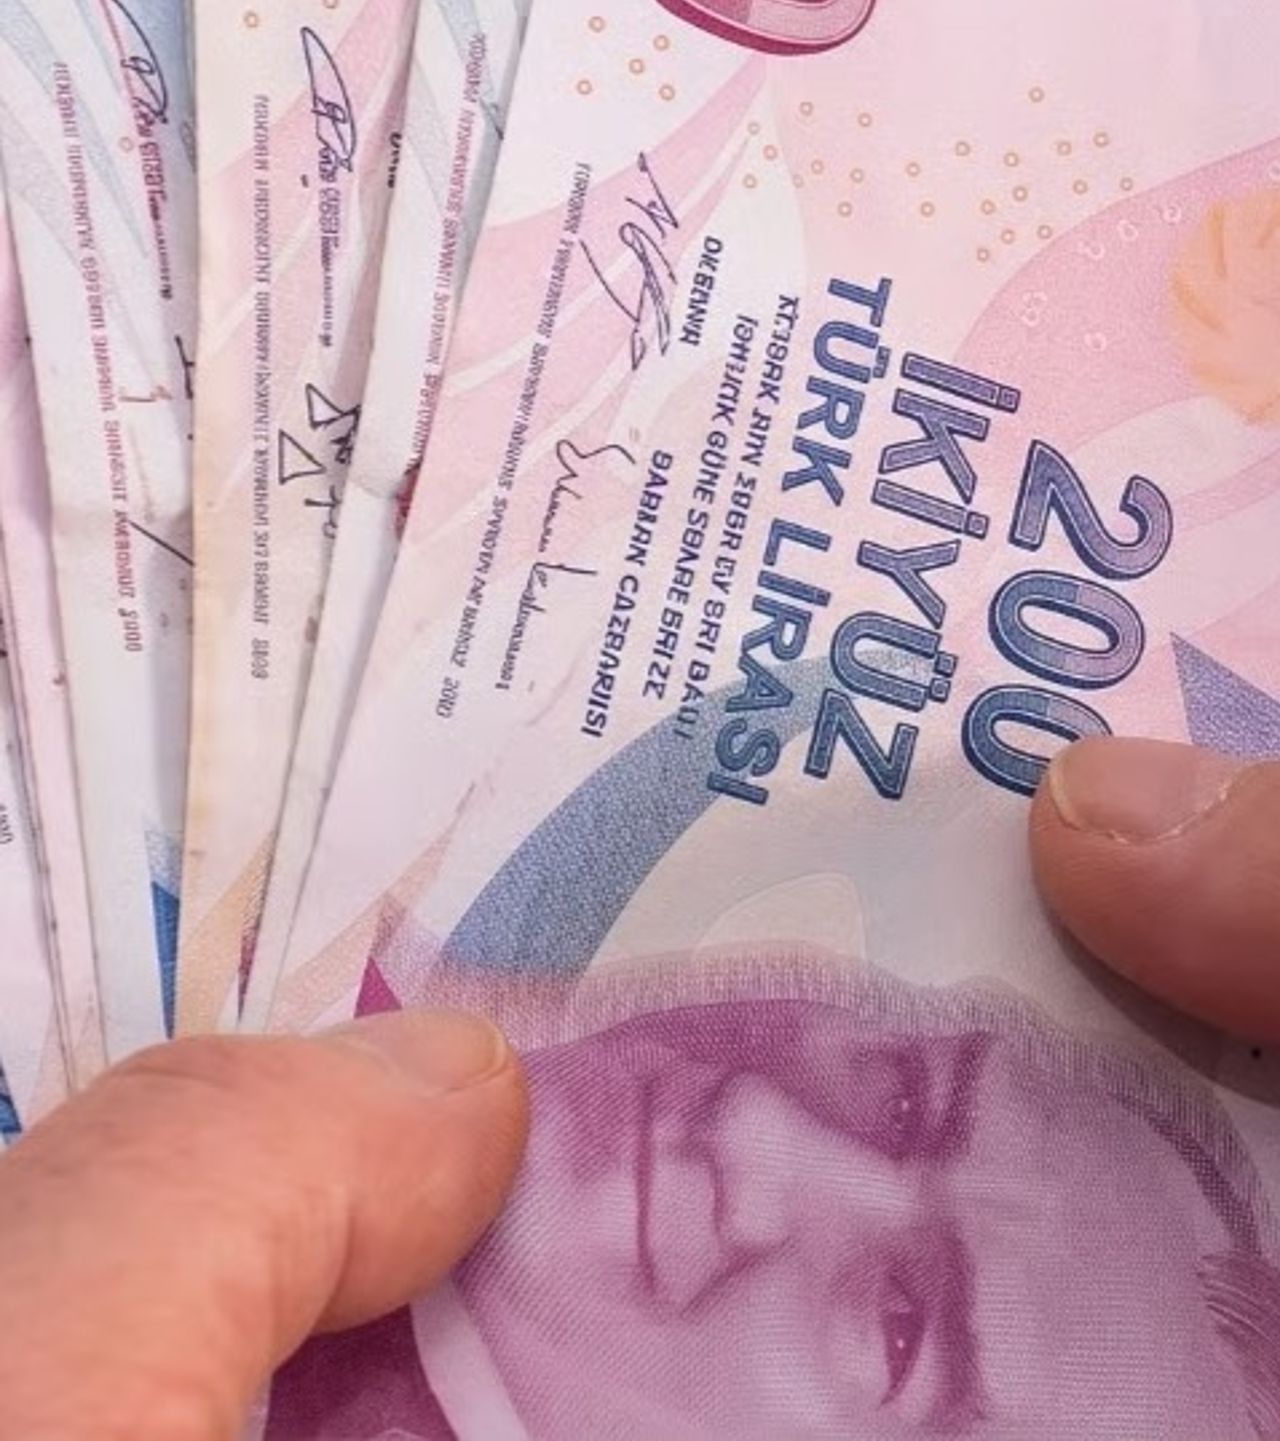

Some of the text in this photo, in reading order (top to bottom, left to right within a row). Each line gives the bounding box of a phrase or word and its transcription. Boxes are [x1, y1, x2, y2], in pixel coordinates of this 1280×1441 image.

[781, 277, 893, 507] TÜRK
[803, 351, 1021, 800] İKİYÜZ
[961, 439, 1173, 797] 200
